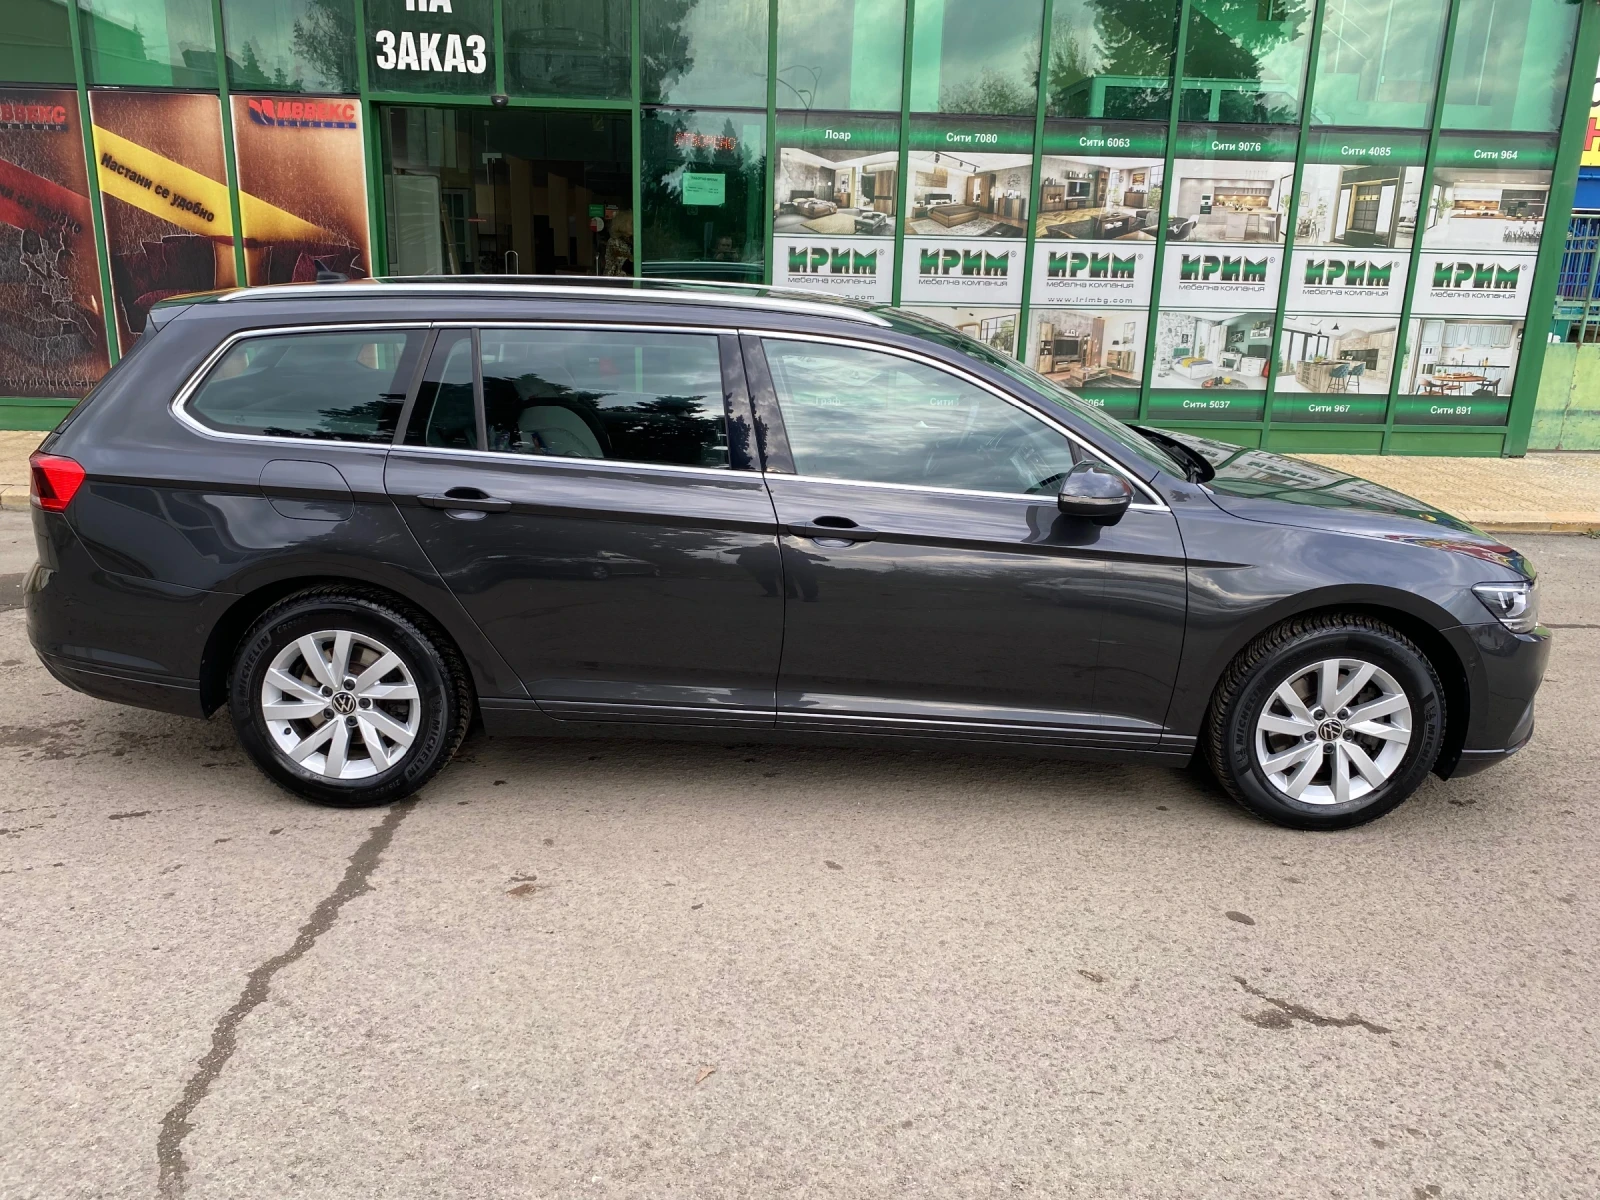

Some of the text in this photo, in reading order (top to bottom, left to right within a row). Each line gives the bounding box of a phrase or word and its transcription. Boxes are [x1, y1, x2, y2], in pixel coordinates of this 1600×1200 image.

[376, 30, 487, 74] ЗАКАЗ
[276, 101, 355, 120] ИВВЕКС
[824, 129, 851, 141] Лоар
[946, 132, 998, 144] Сити 7080
[1079, 137, 1131, 148] Сити 6063
[1211, 141, 1262, 152] Сити 9076
[1341, 146, 1392, 157] Сити 4085
[1474, 149, 1519, 160] Сити 964
[100, 152, 216, 222] Настани се удобно
[787, 245, 878, 275] ИРИМ
[918, 247, 1009, 277] ИРИМ
[1047, 250, 1137, 279] ИРИМ
[1179, 253, 1269, 282] ИРИМ
[1303, 258, 1393, 288] ИРИМ
[787, 276, 877, 286] мебелна компания
[1431, 261, 1522, 290] ИРИМ
[918, 278, 1008, 288] мебелна компания
[1046, 281, 1134, 290] мебелна компания
[1178, 284, 1265, 293] мебелна компания
[1302, 288, 1389, 298] мебелна компания
[1430, 291, 1516, 300] мебелна компания
[1182, 400, 1231, 409] Сити 5037
[1308, 404, 1351, 413] Сити 967
[1430, 405, 1473, 415] Сити 891
[239, 635, 269, 699] MICHELIN
[407, 719, 441, 778] MICHELIN
